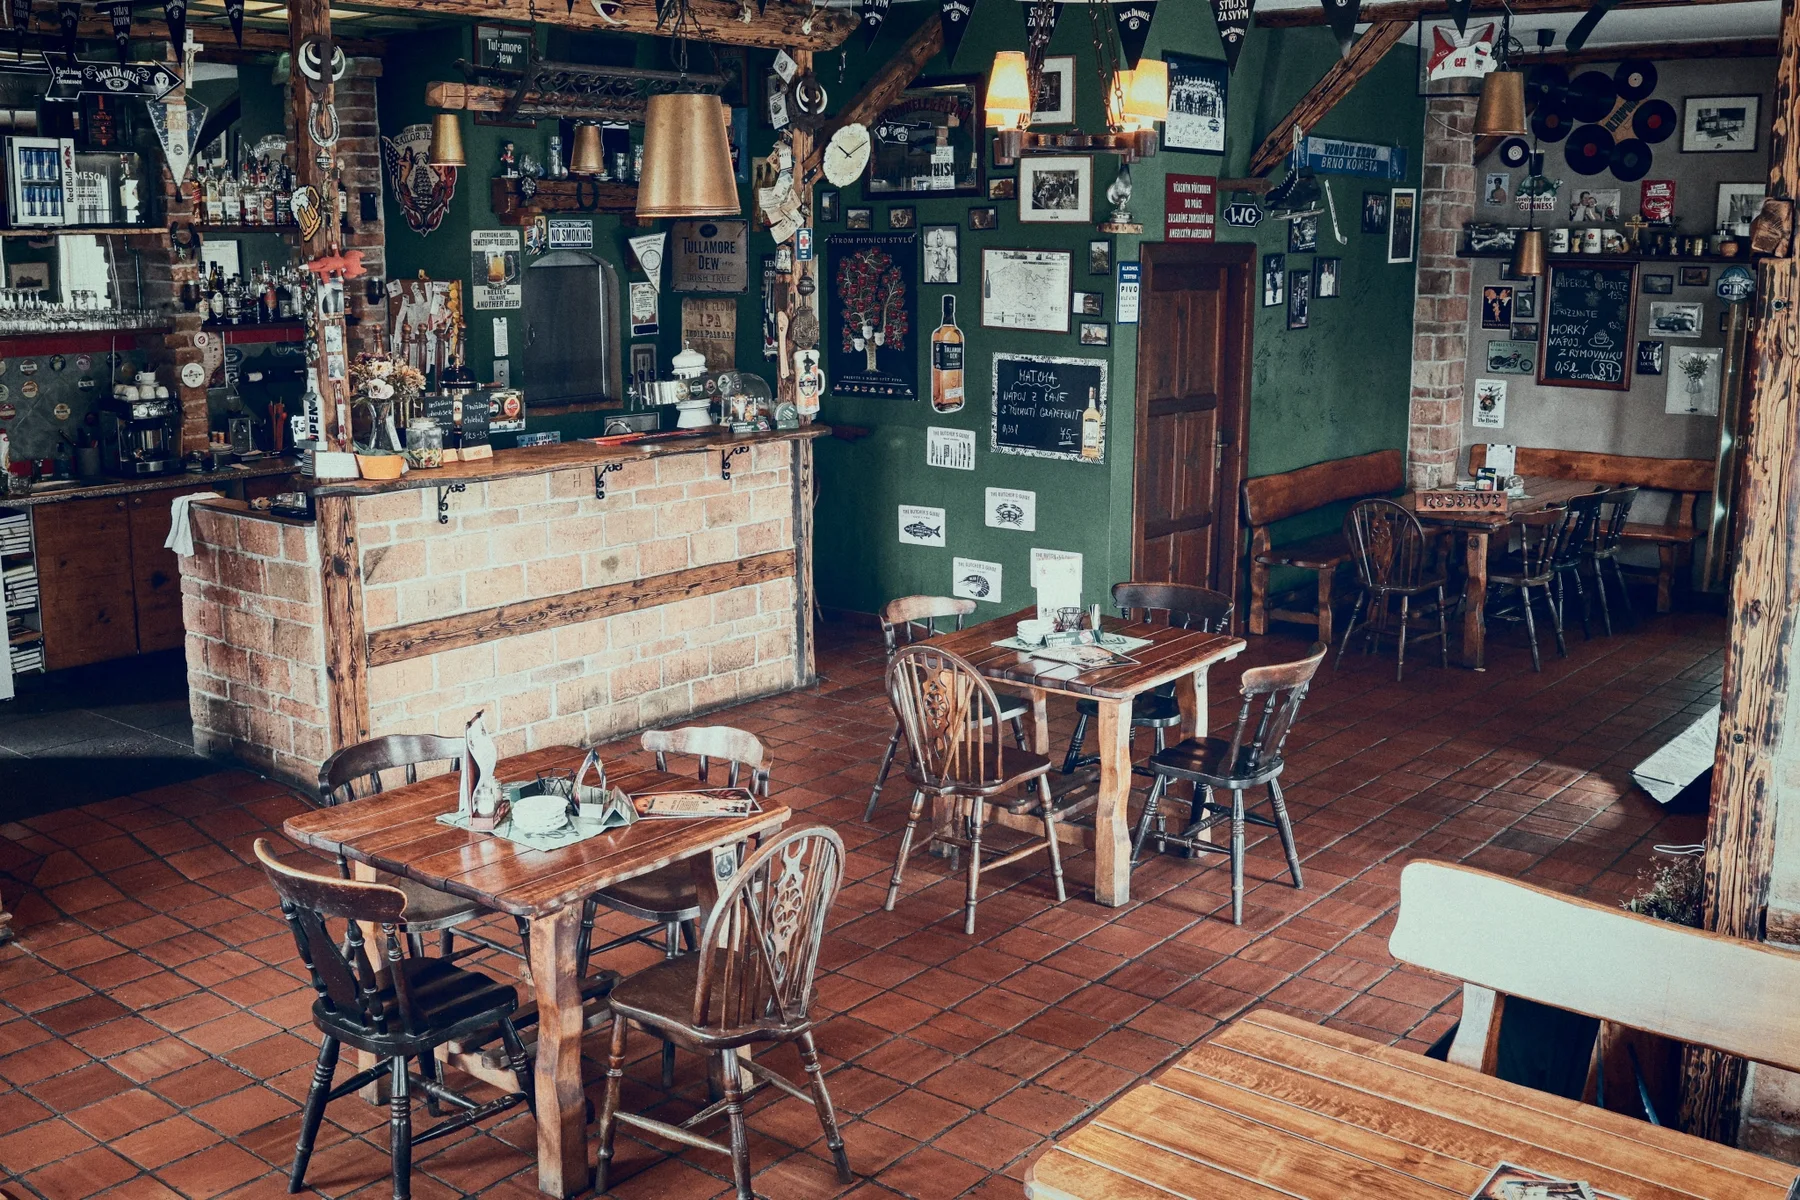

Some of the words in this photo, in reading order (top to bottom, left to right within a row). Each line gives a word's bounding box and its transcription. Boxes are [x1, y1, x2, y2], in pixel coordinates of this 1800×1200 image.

[1120, 12, 1131, 22] JACK
[1131, 8, 1150, 22] DANIEL'S
[1218, 12, 1227, 22] ZA
[1228, 8, 1248, 20] SVÝM
[95, 68, 112, 82] JACK
[394, 132, 420, 148] SAILOR
[1356, 146, 1377, 158] BRNO
[1321, 156, 1344, 170] BRNO
[1346, 159, 1378, 172] KOMETA
[65, 170, 73, 187] Bull
[66, 187, 74, 203] Red
[1230, 207, 1256, 224] WC
[552, 228, 560, 242] NO
[562, 228, 592, 242] SMOKING
[856, 236, 886, 244] PIVNÍCH
[682, 237, 736, 254] TULLAMORE
[698, 255, 720, 270] DEW
[686, 274, 708, 282] IRISH
[1556, 272, 1591, 289] APEROL
[476, 300, 503, 308] ANOTHER
[504, 300, 520, 308] BEER
[1552, 302, 1598, 318] FRIZZANTE
[699, 314, 722, 328] IPA
[1550, 320, 1588, 336] HORKÝ
[1558, 348, 1566, 357] Z
[1641, 352, 1659, 360] VIP
[1019, 369, 1058, 384] MATCHA
[1422, 492, 1502, 509] RESERVE
